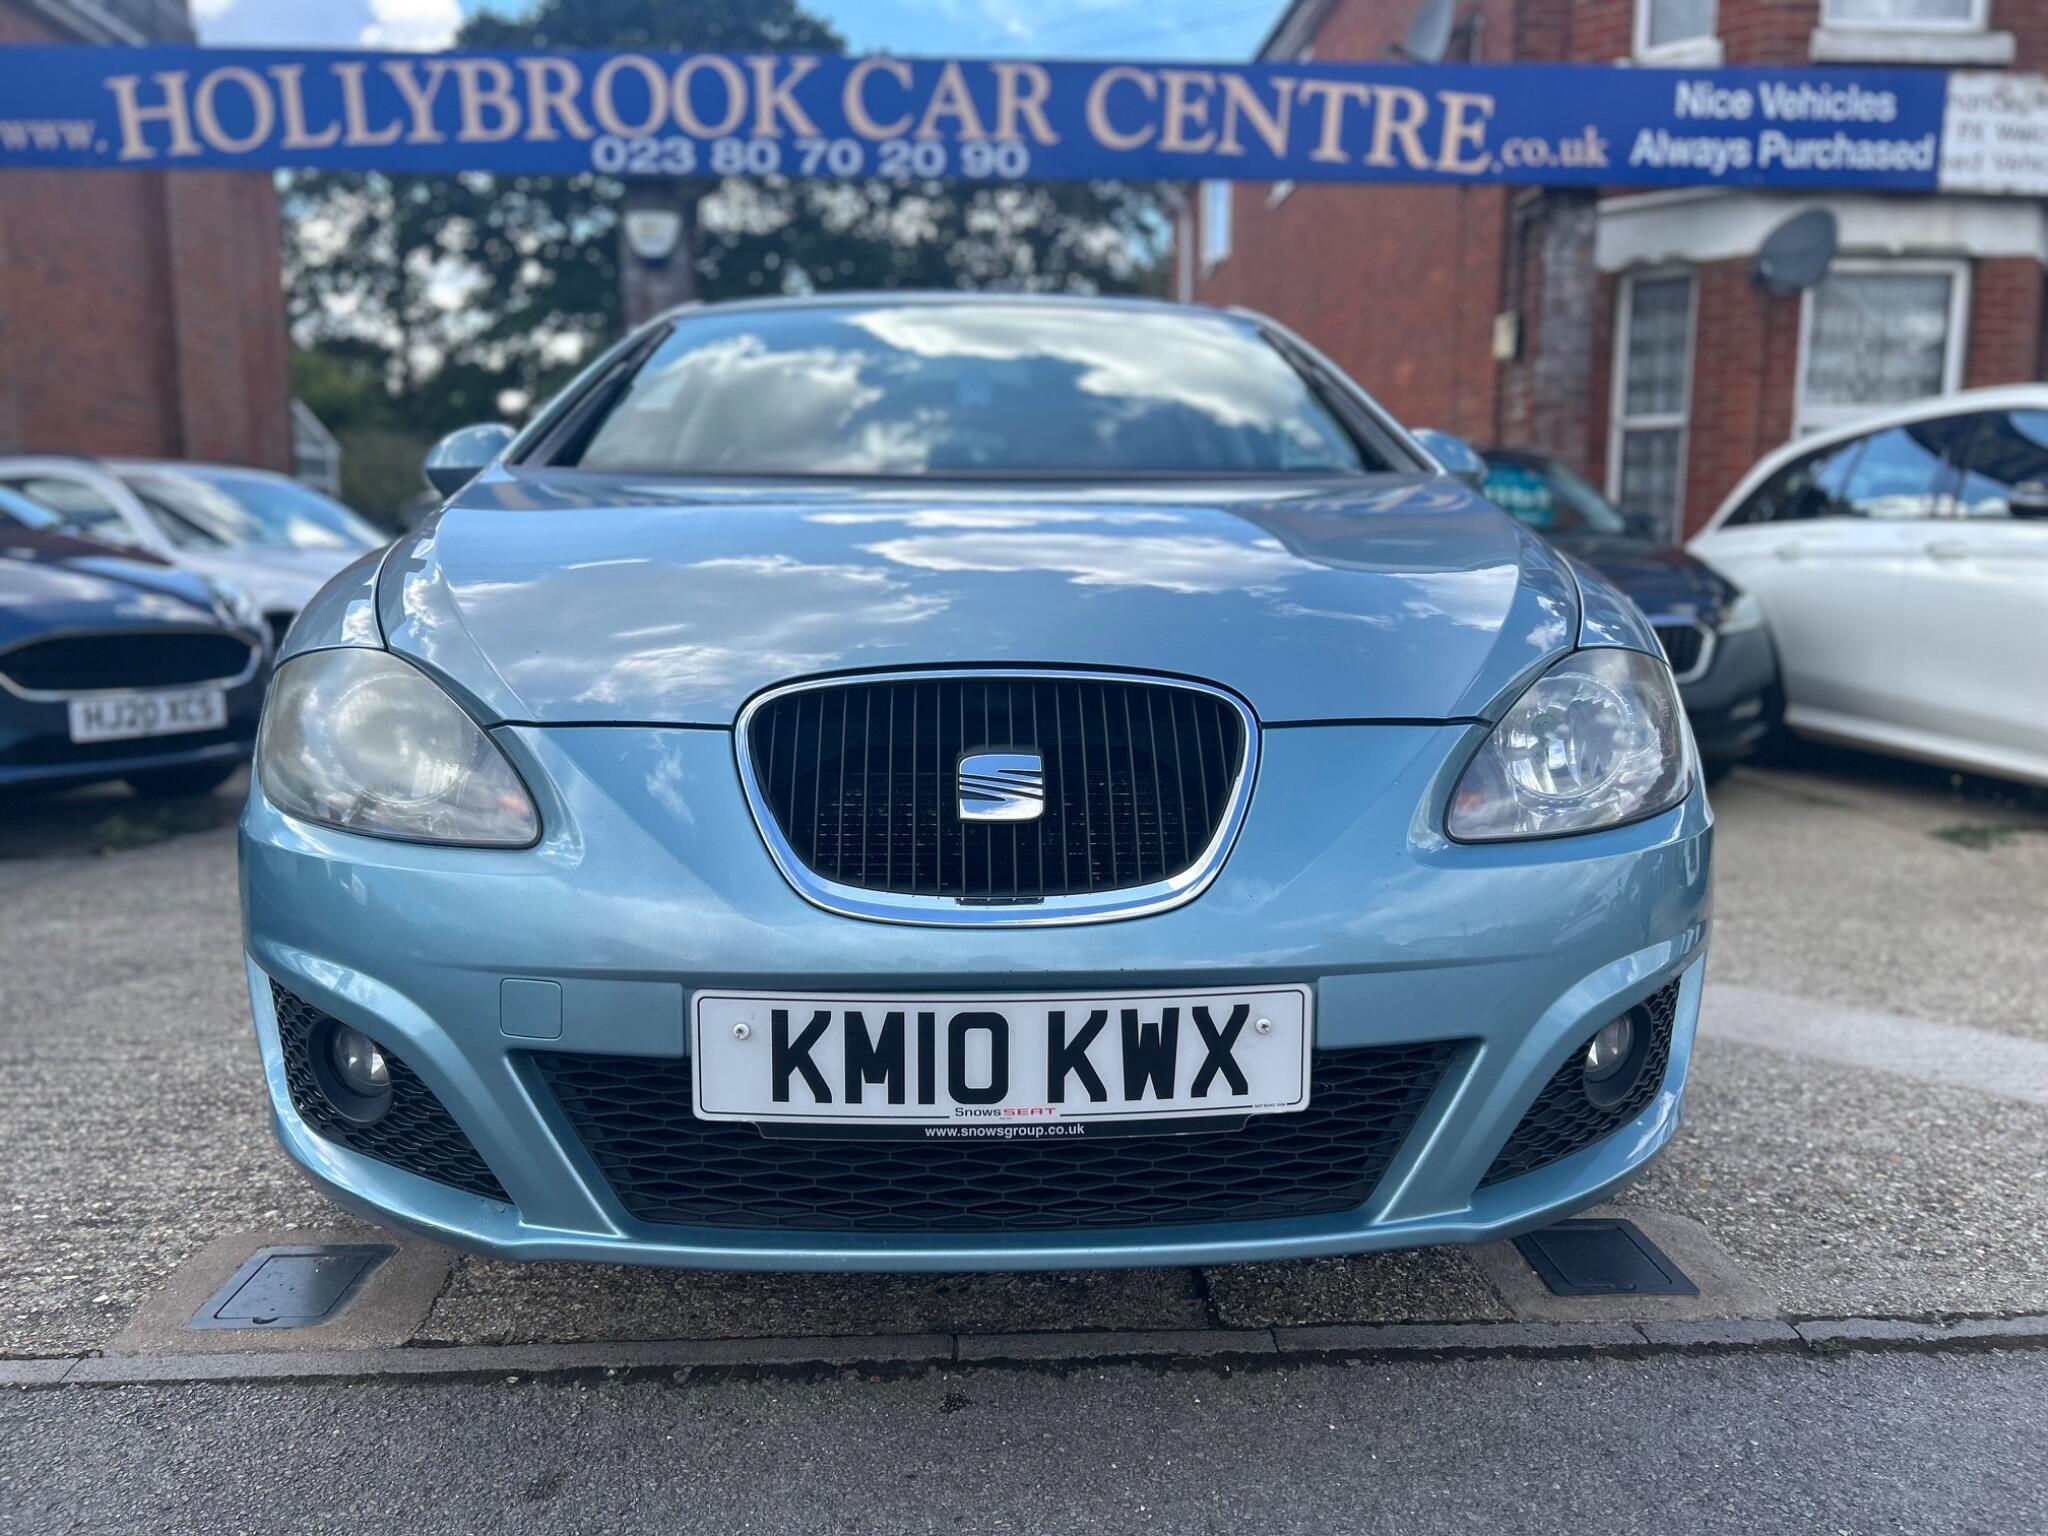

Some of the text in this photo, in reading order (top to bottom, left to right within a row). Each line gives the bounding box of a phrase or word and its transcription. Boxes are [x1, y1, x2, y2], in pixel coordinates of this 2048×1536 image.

[104, 53, 821, 161] HOLLYBROOK
[842, 56, 1060, 145] CAR
[1674, 80, 1898, 123] Nice Vehicles
[591, 135, 1030, 178] 023 80 70 20 90
[1628, 129, 1752, 175] Always
[1757, 129, 1937, 171] Purchased
[771, 1003, 1250, 1105] KM10 KWX
[925, 1123, 1085, 1139] www.snowsgroup.co.uk
[955, 1107, 1056, 1117] Snows SEAT
